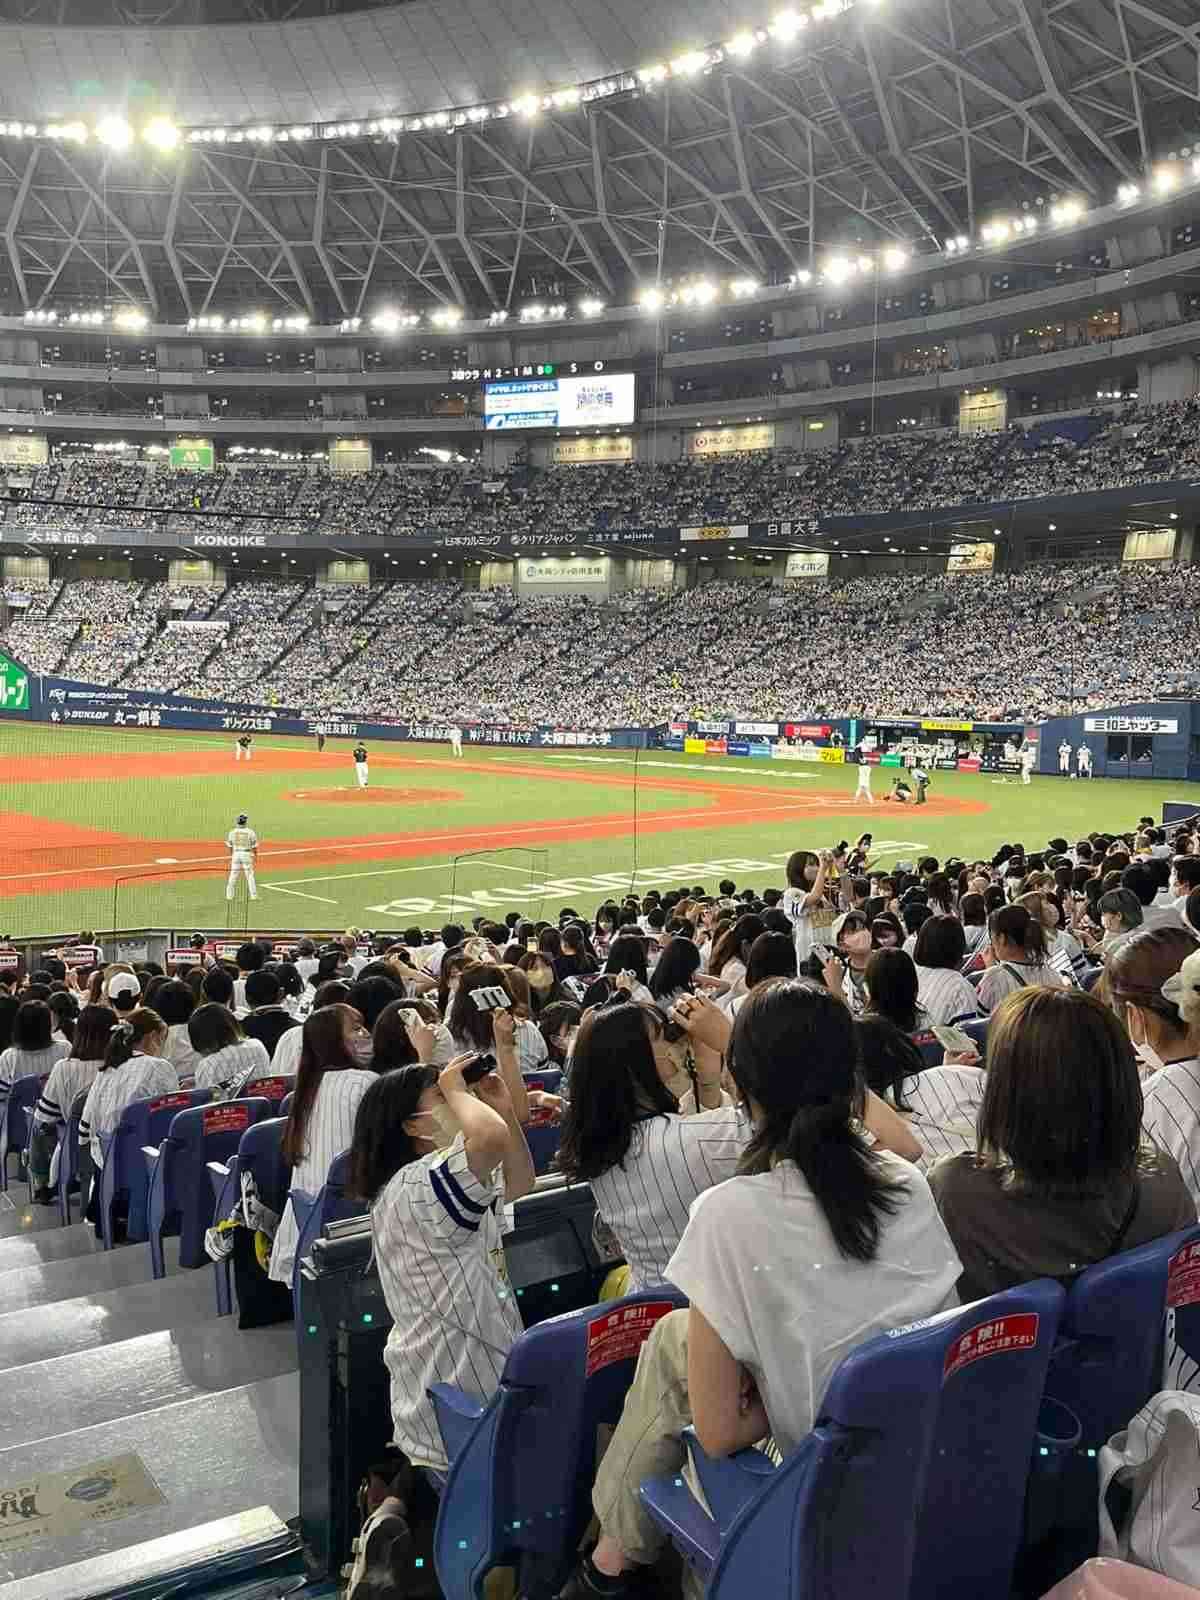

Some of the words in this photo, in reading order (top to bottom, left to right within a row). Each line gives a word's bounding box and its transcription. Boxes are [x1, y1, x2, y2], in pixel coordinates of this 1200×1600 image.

[495, 368, 502, 378] 2
[570, 362, 577, 373] S
[194, 534, 266, 546] KONOIKE
[71, 710, 109, 720] DUNLOP
[222, 717, 272, 730] オリックス生命
[1094, 719, 1168, 731] 三和シャッター
